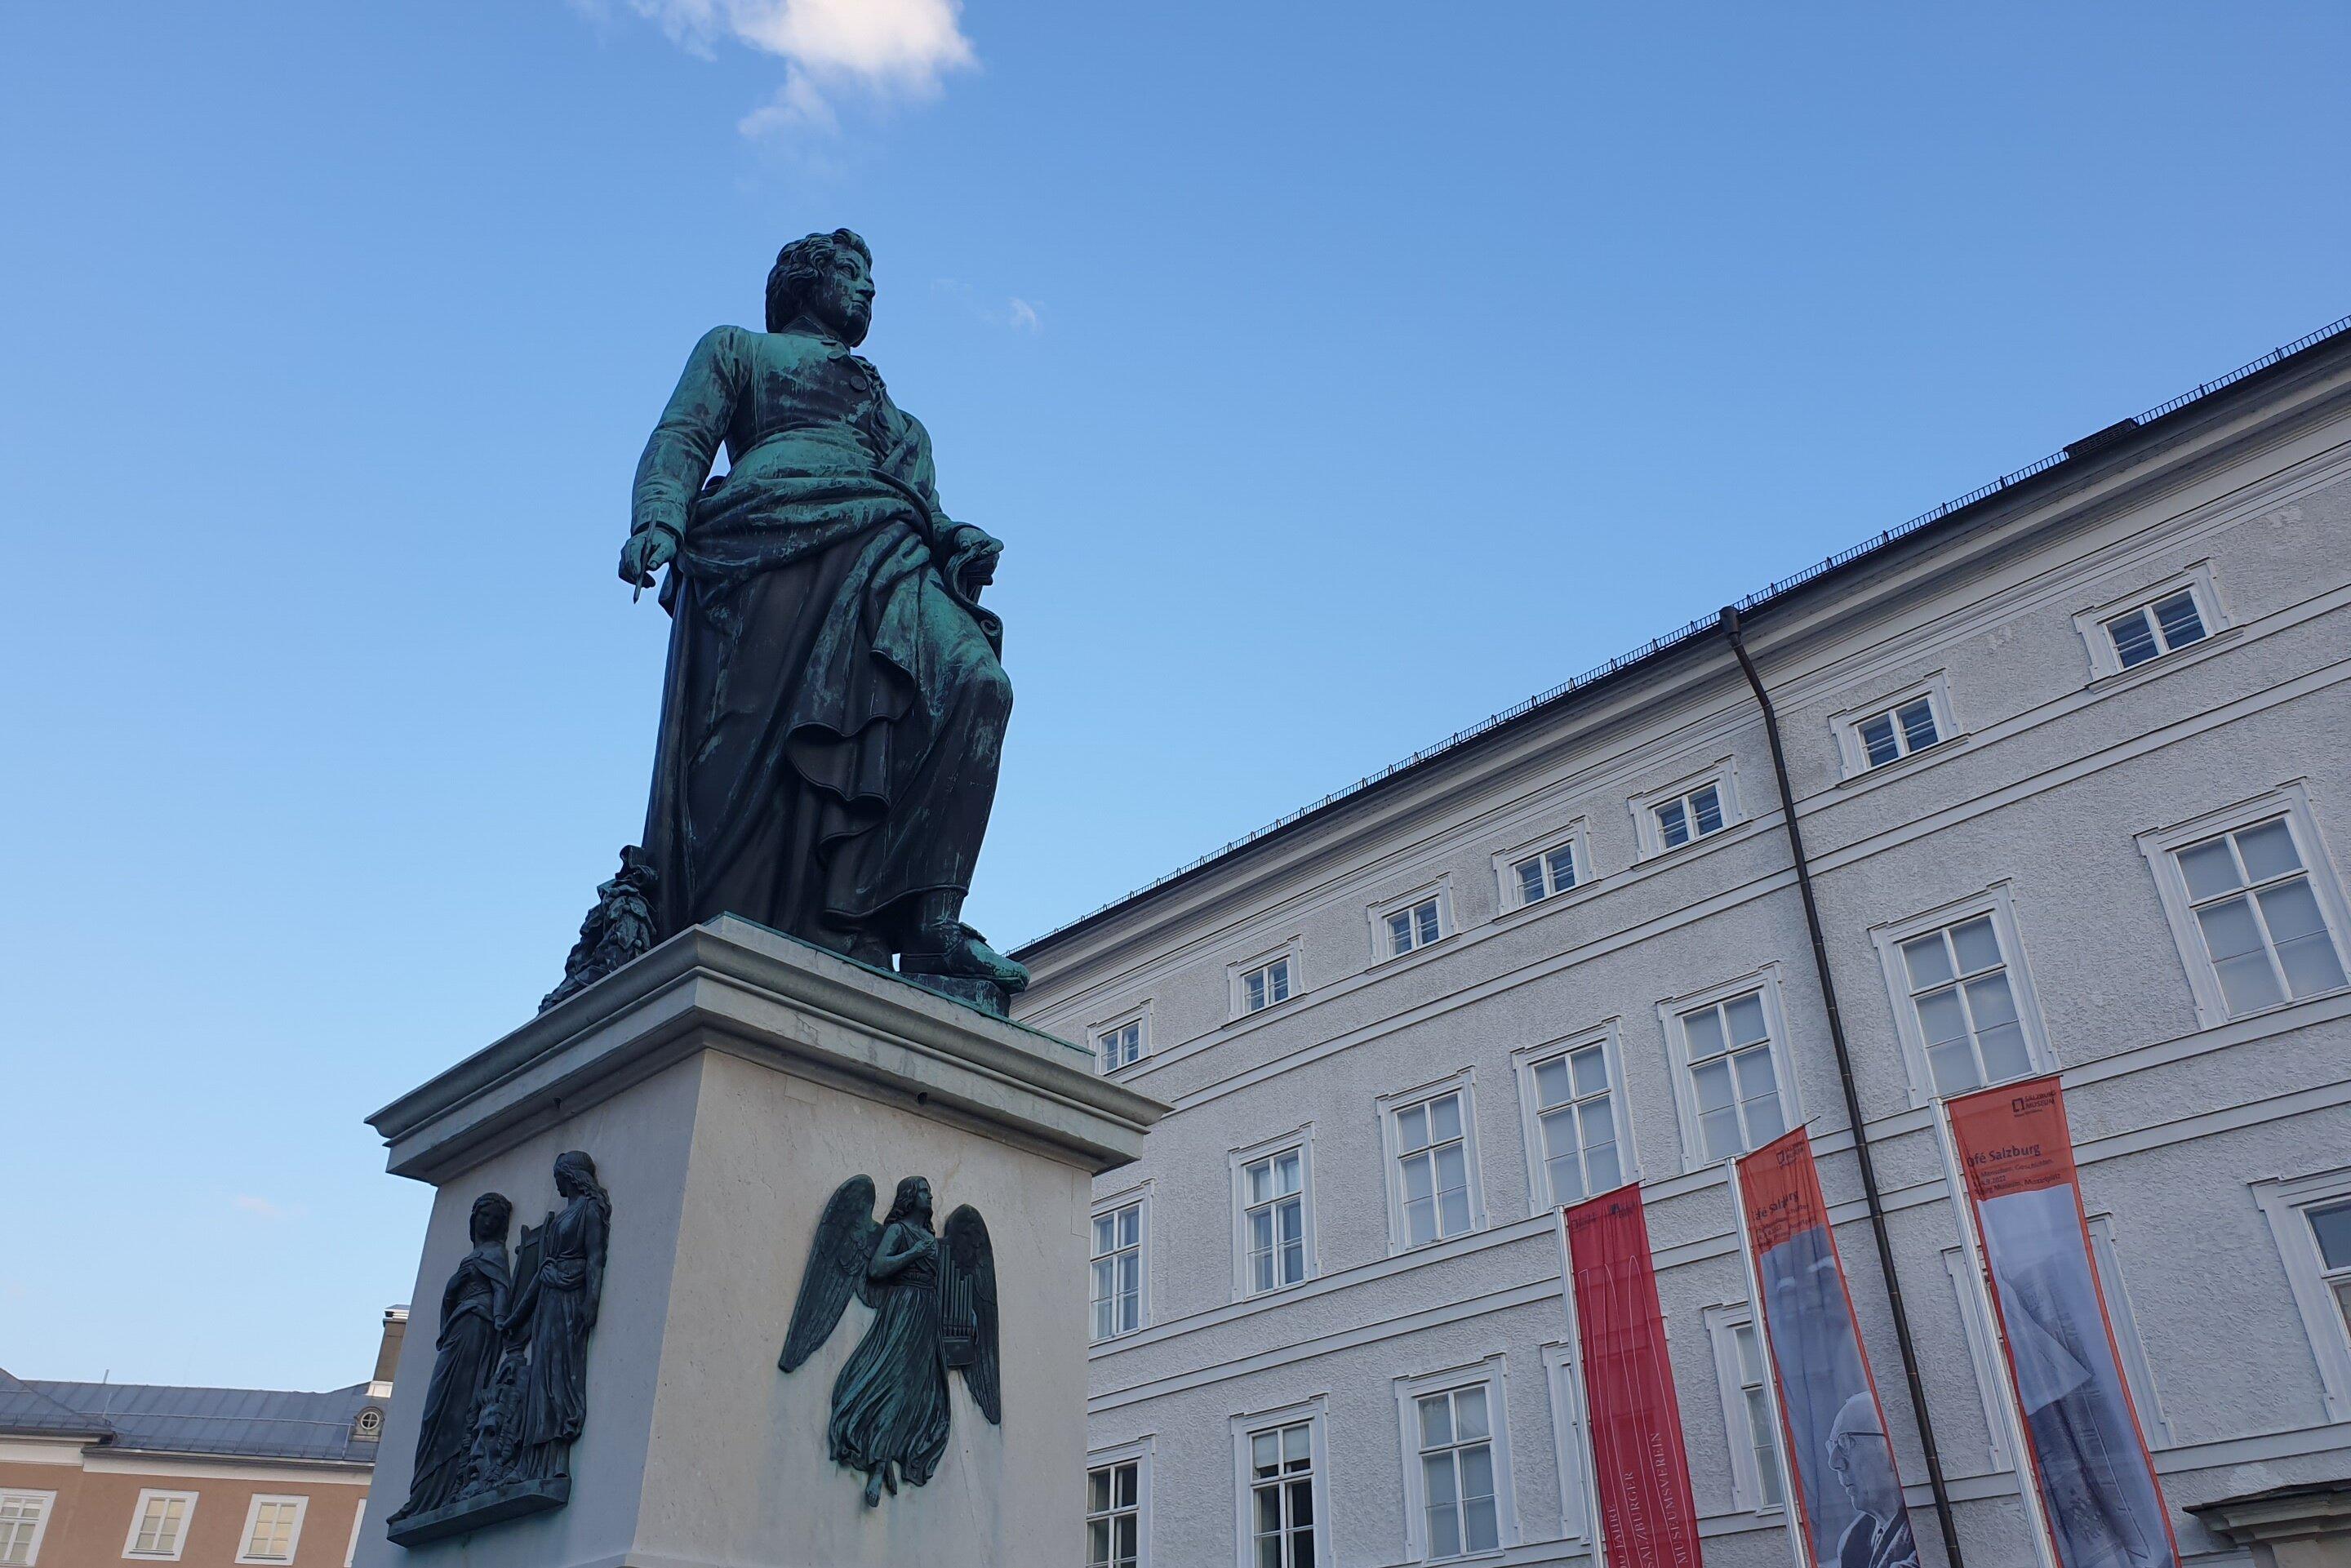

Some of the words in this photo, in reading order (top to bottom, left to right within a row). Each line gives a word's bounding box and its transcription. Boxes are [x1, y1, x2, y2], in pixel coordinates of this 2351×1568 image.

[1989, 1144, 2041, 1162] Salzburg
[1607, 1504, 1625, 1548] JAHRE
[1624, 1471, 1655, 1568] SALZBURGER
[1650, 1433, 1688, 1564] MUSEUMSVEREIN
